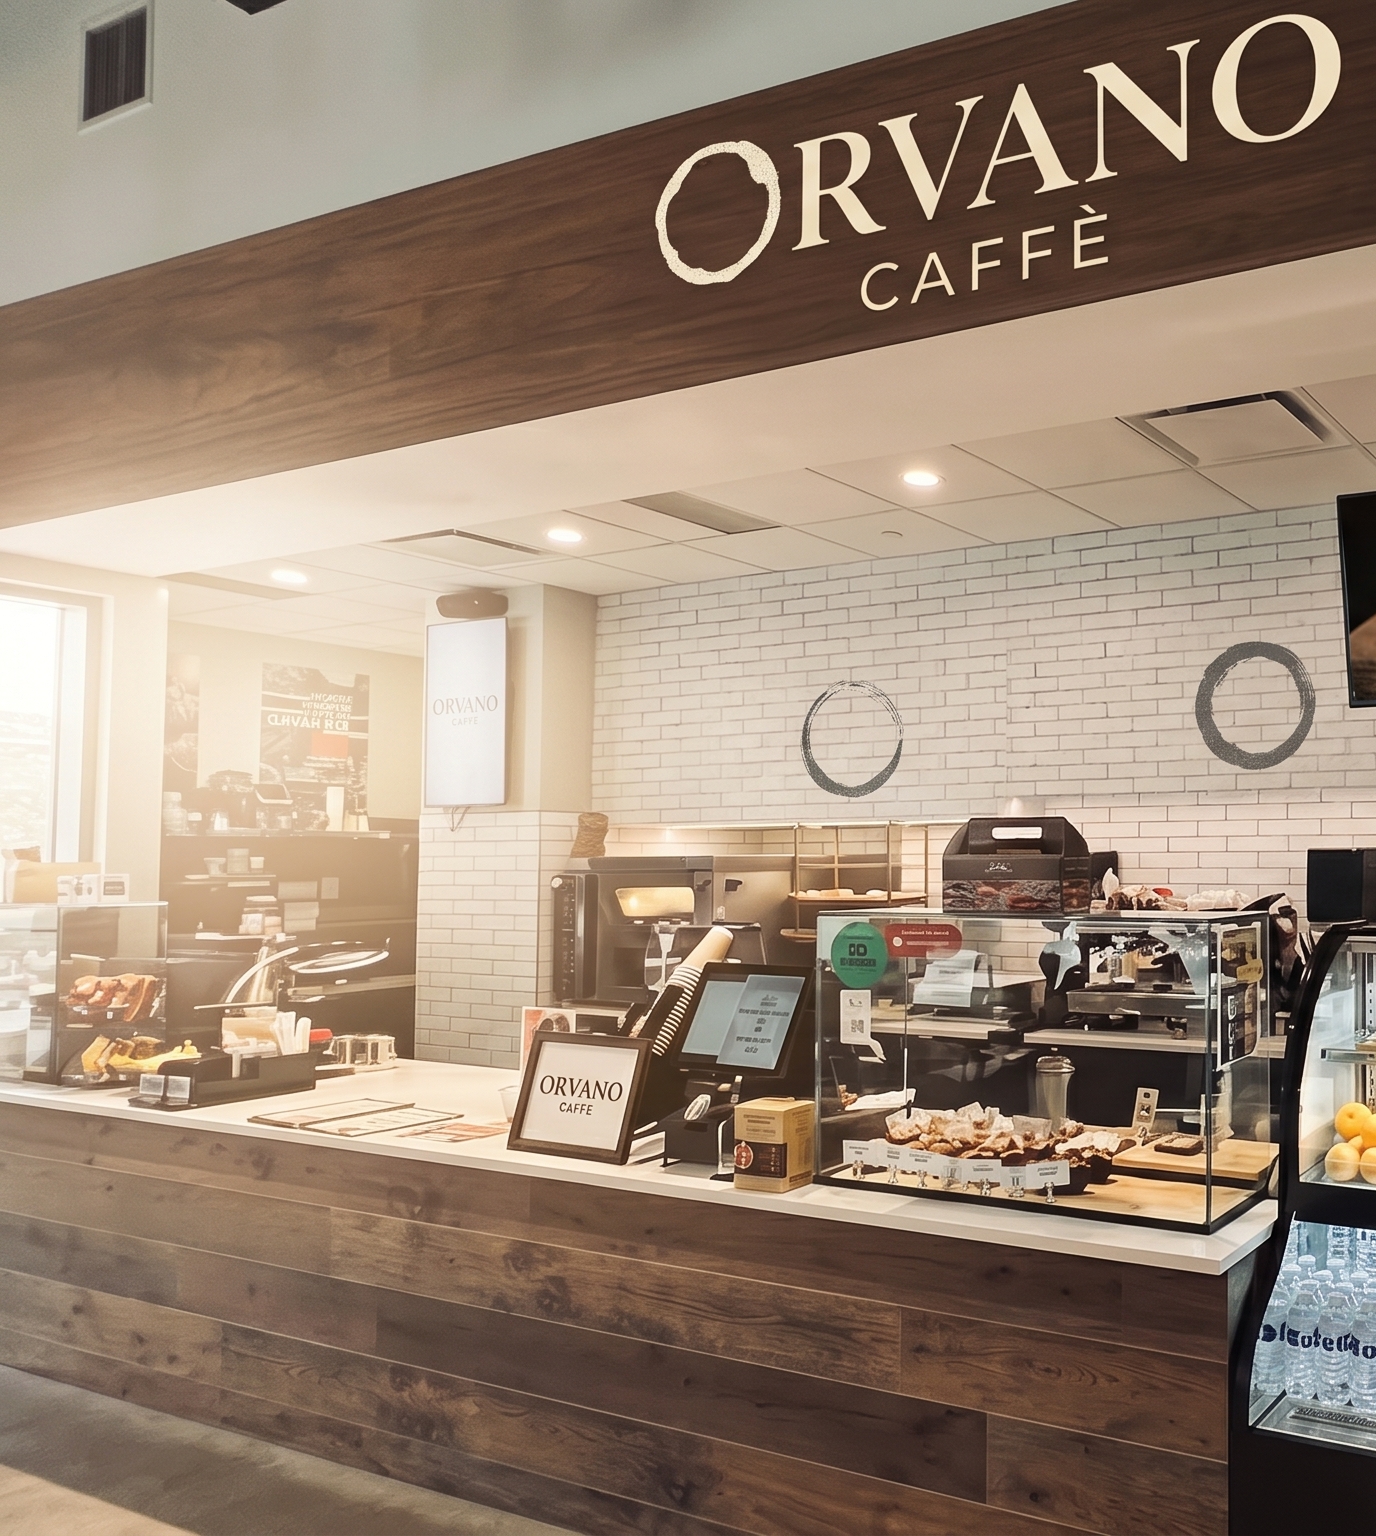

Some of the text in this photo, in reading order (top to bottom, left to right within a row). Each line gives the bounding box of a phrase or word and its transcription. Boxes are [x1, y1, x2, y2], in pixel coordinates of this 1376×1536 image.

[655, 13, 1342, 286] ORVANO
[860, 204, 1110, 311] CAFFÈ
[433, 694, 498, 716] ORVANO
[540, 1075, 623, 1102] ORVANO
